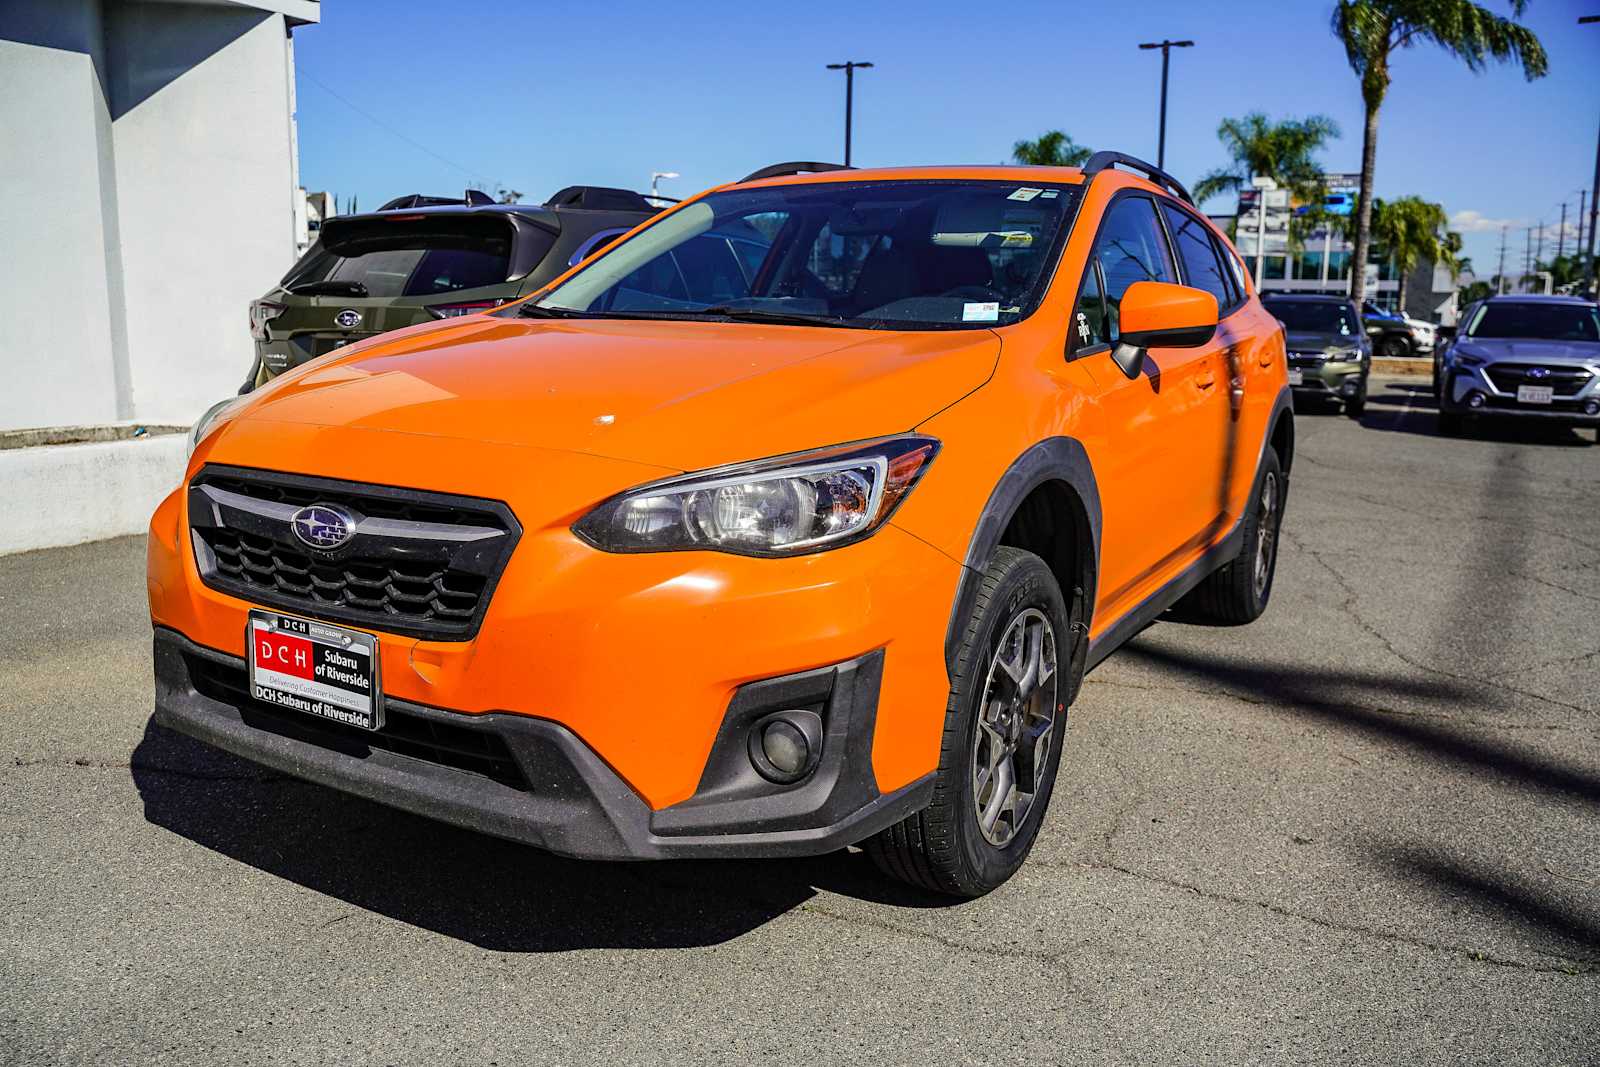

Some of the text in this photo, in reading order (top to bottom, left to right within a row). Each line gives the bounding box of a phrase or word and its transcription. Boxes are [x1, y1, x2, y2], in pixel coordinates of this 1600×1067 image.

[283, 619, 306, 633] DCH
[262, 641, 306, 668] DCH
[324, 650, 358, 670] Subaru
[315, 664, 369, 688] of Riverside
[269, 675, 361, 706] Delivering Customer Happiness
[256, 685, 370, 728] DCH Subaru of Riverside
